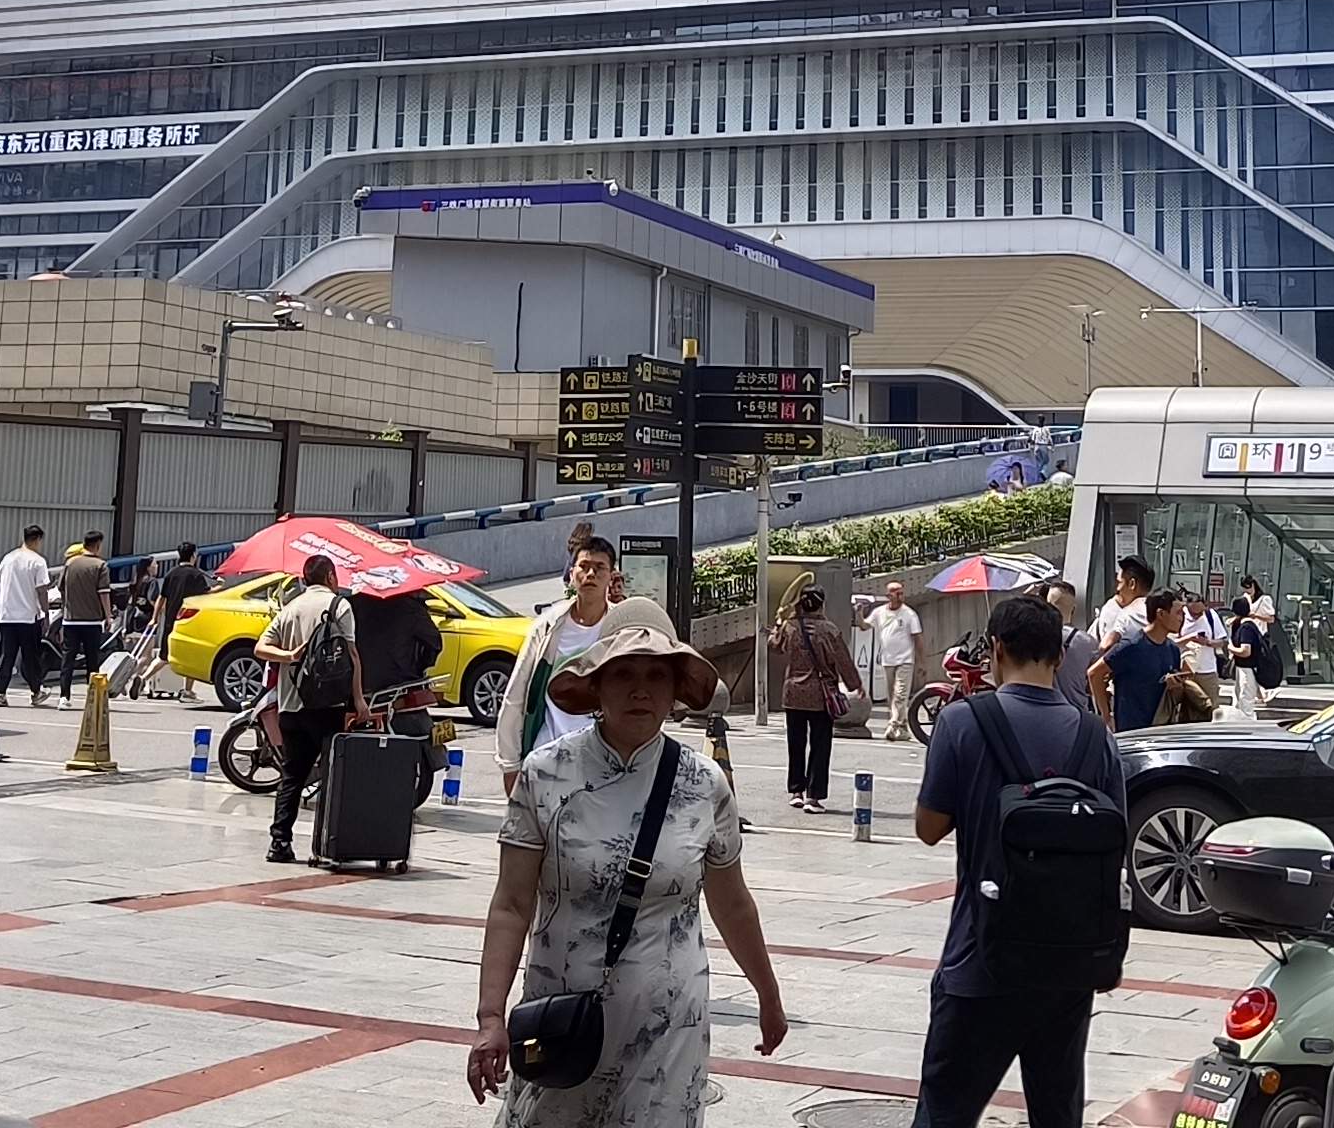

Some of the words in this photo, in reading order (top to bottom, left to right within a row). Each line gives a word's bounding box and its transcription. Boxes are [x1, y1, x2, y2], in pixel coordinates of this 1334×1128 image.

[1252, 442, 1273, 457] 环
[1287, 443, 1295, 459] 1
[1309, 443, 1322, 460] 9
